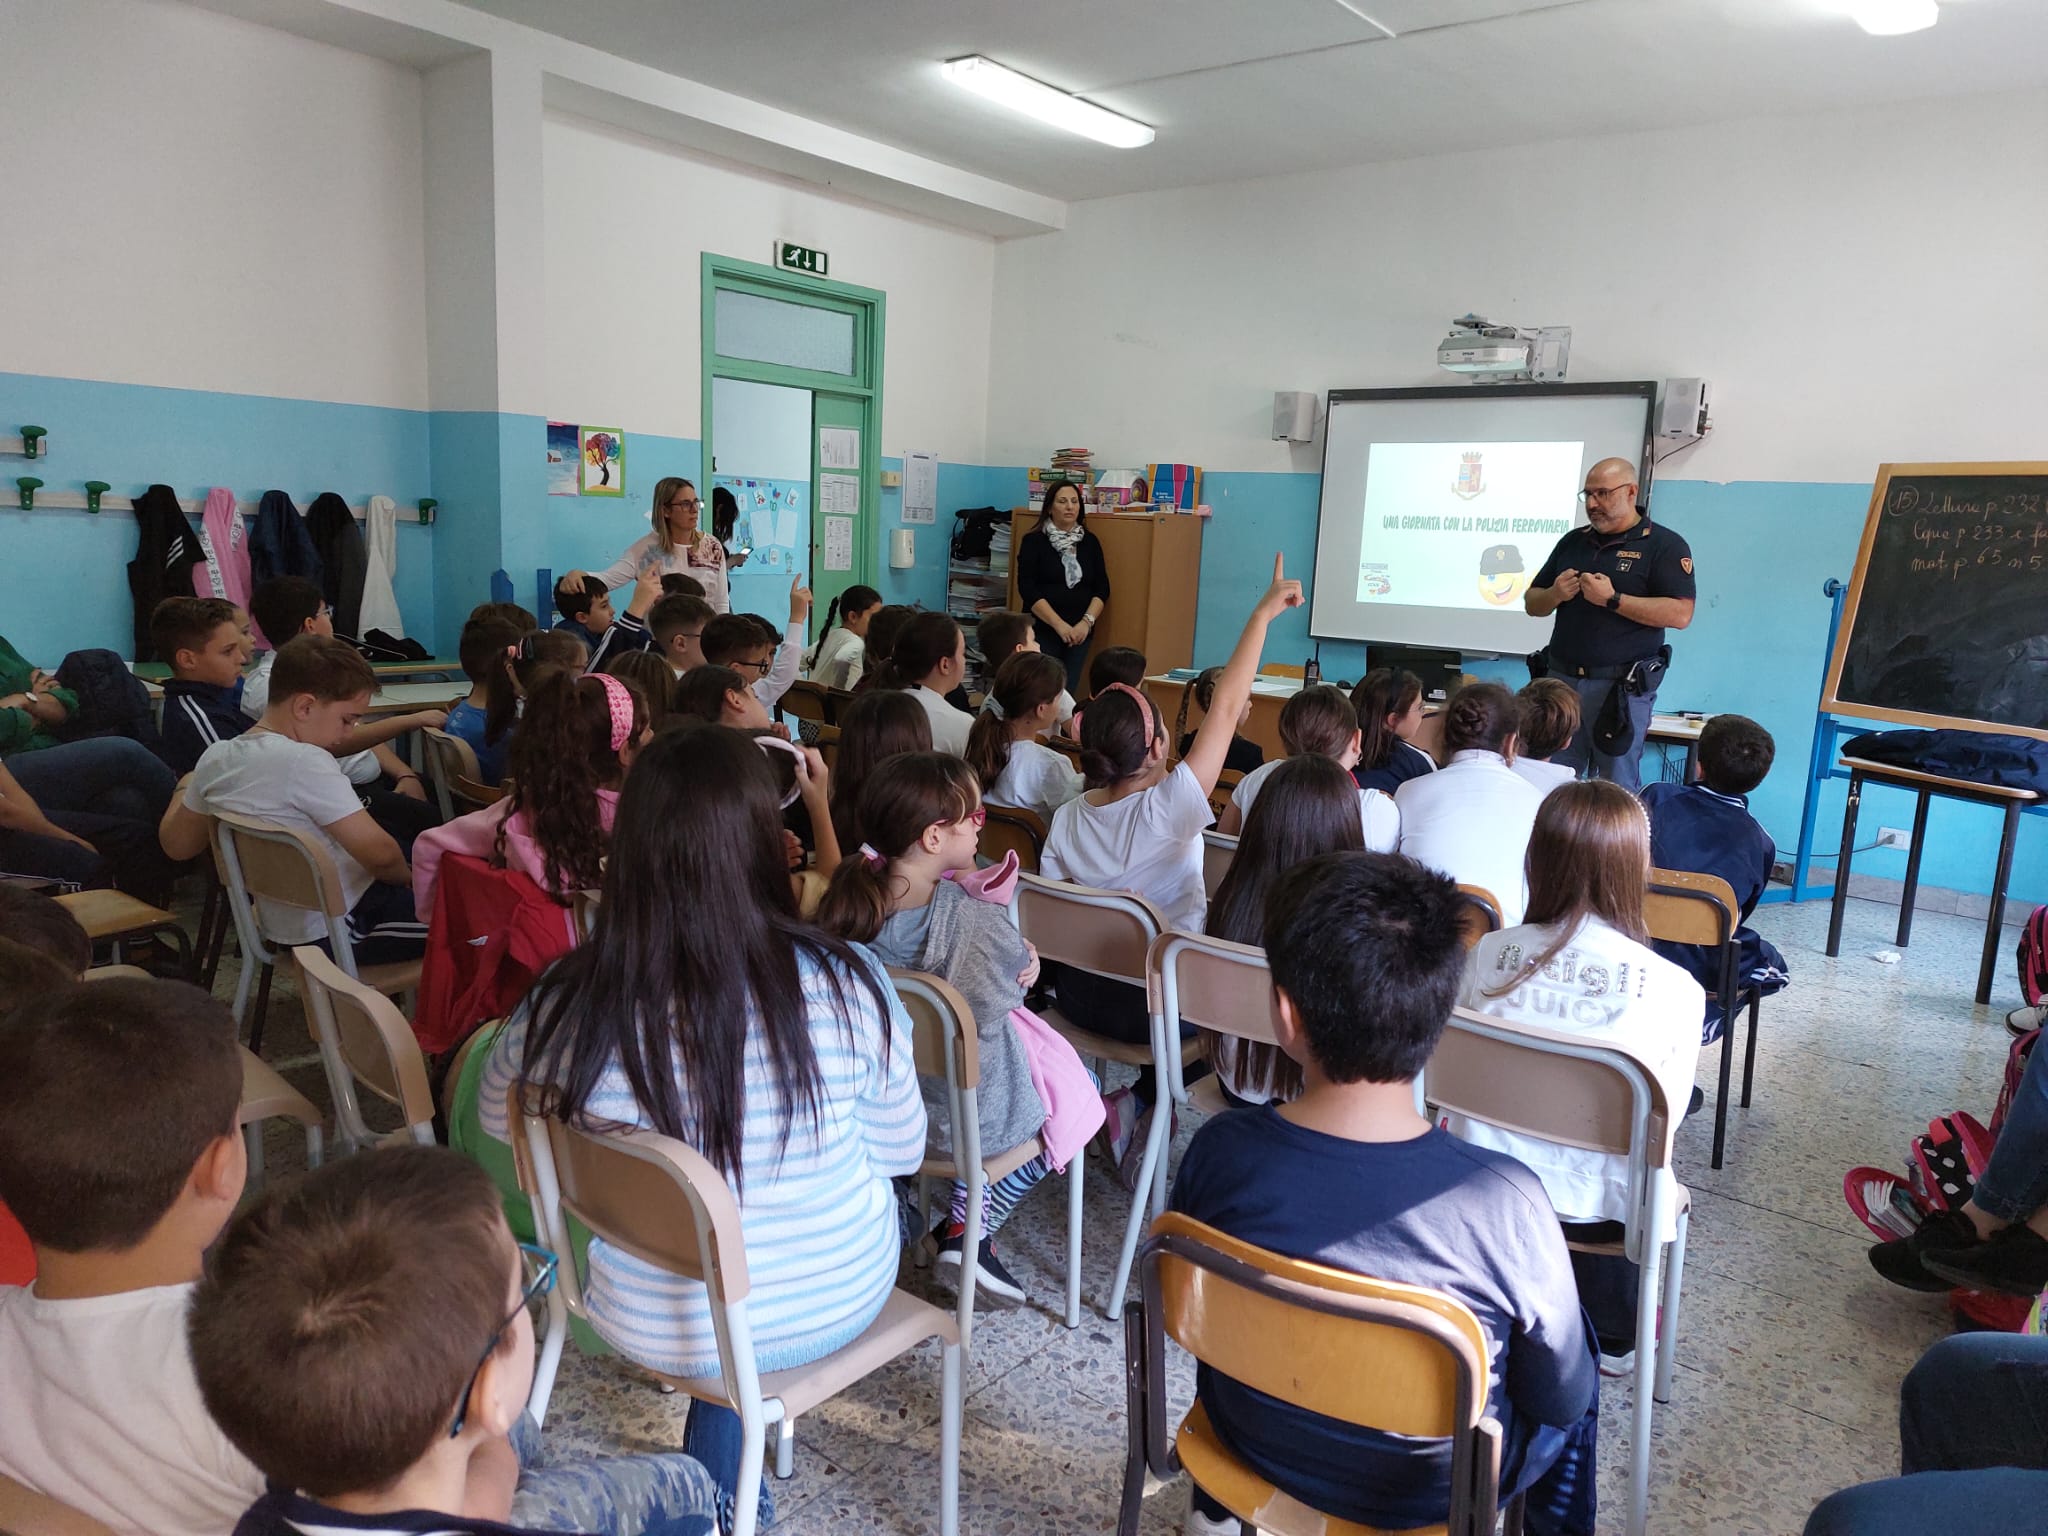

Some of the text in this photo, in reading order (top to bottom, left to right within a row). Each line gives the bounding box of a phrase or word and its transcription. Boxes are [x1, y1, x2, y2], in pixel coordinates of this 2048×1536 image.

[1383, 514, 1570, 534] UNA GIORNATA CON LA POLIZIA FERROVIARIA
[1972, 524, 2004, 541] 233
[1507, 984, 1625, 1025] JUICY
